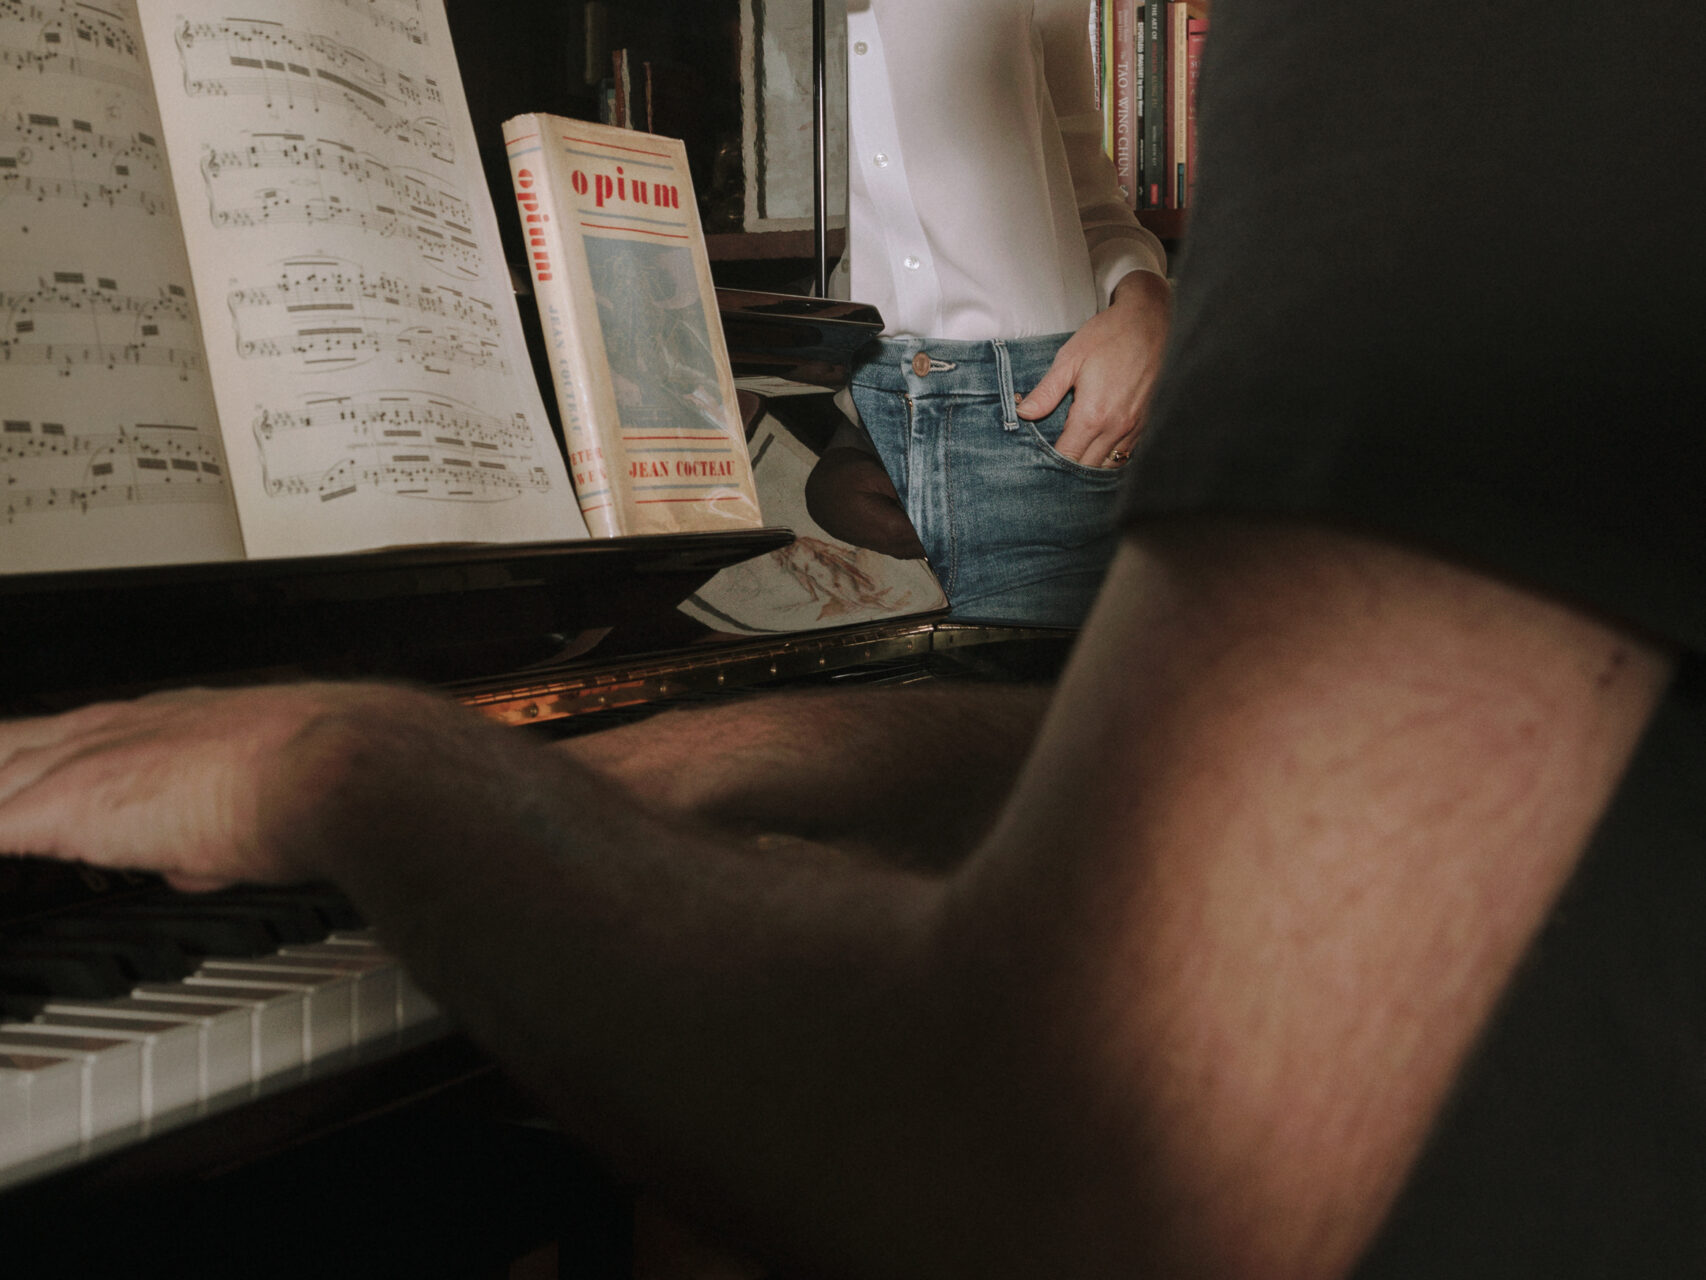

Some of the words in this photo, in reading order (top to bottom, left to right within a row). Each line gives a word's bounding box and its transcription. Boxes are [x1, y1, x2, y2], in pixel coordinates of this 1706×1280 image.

[1117, 61, 1129, 88] TAO
[1118, 96, 1129, 133] WING
[1117, 137, 1129, 177] CHUN
[572, 165, 680, 209] opium
[517, 168, 554, 283] opium
[549, 305, 566, 349] JEAN
[628, 460, 669, 479] JEAN
[675, 460, 736, 478] COCTEAU
